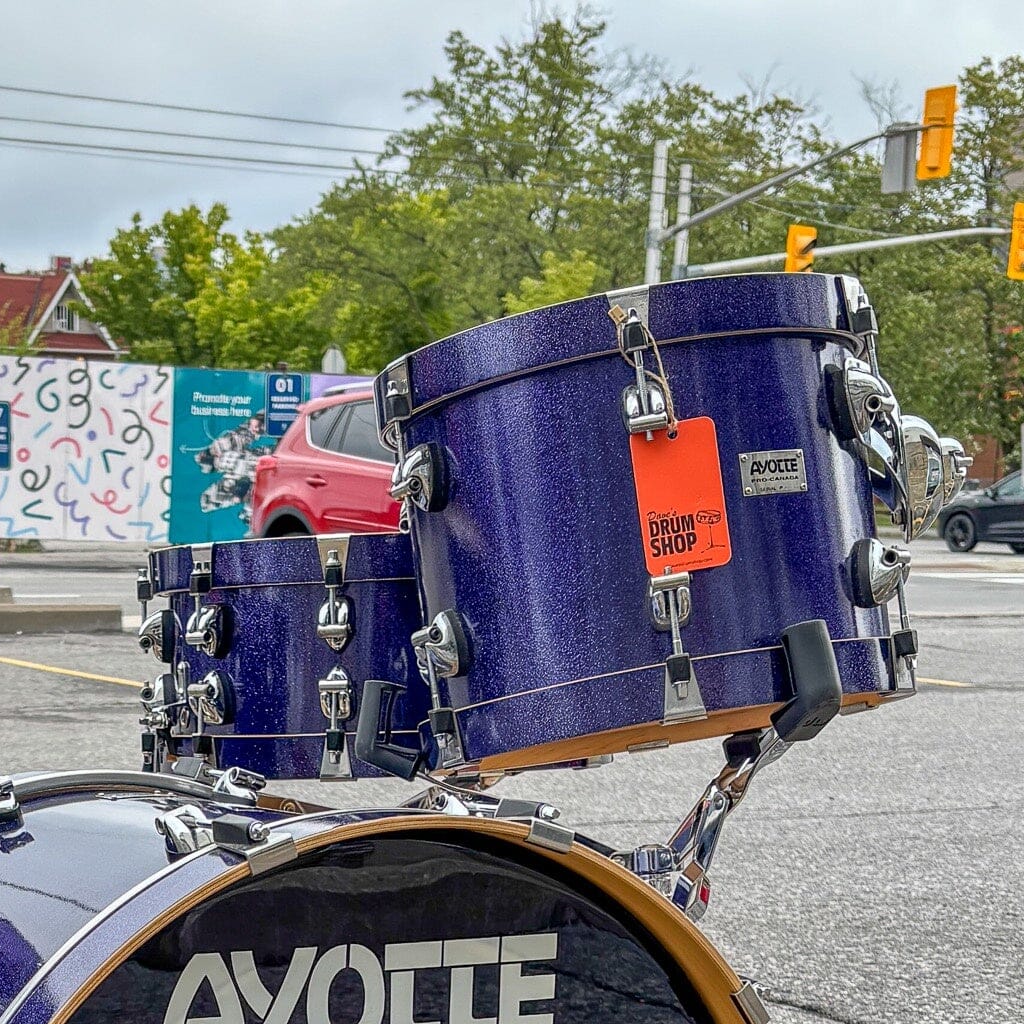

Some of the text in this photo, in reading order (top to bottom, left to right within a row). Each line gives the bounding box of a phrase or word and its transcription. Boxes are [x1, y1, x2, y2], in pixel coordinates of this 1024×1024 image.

[275, 378, 294, 393] 01
[192, 391, 252, 406] Promote your
[190, 404, 252, 417] business here
[750, 458, 799, 476] AYOTTE
[649, 513, 695, 538] DRUM
[650, 532, 697, 558] SHOP
